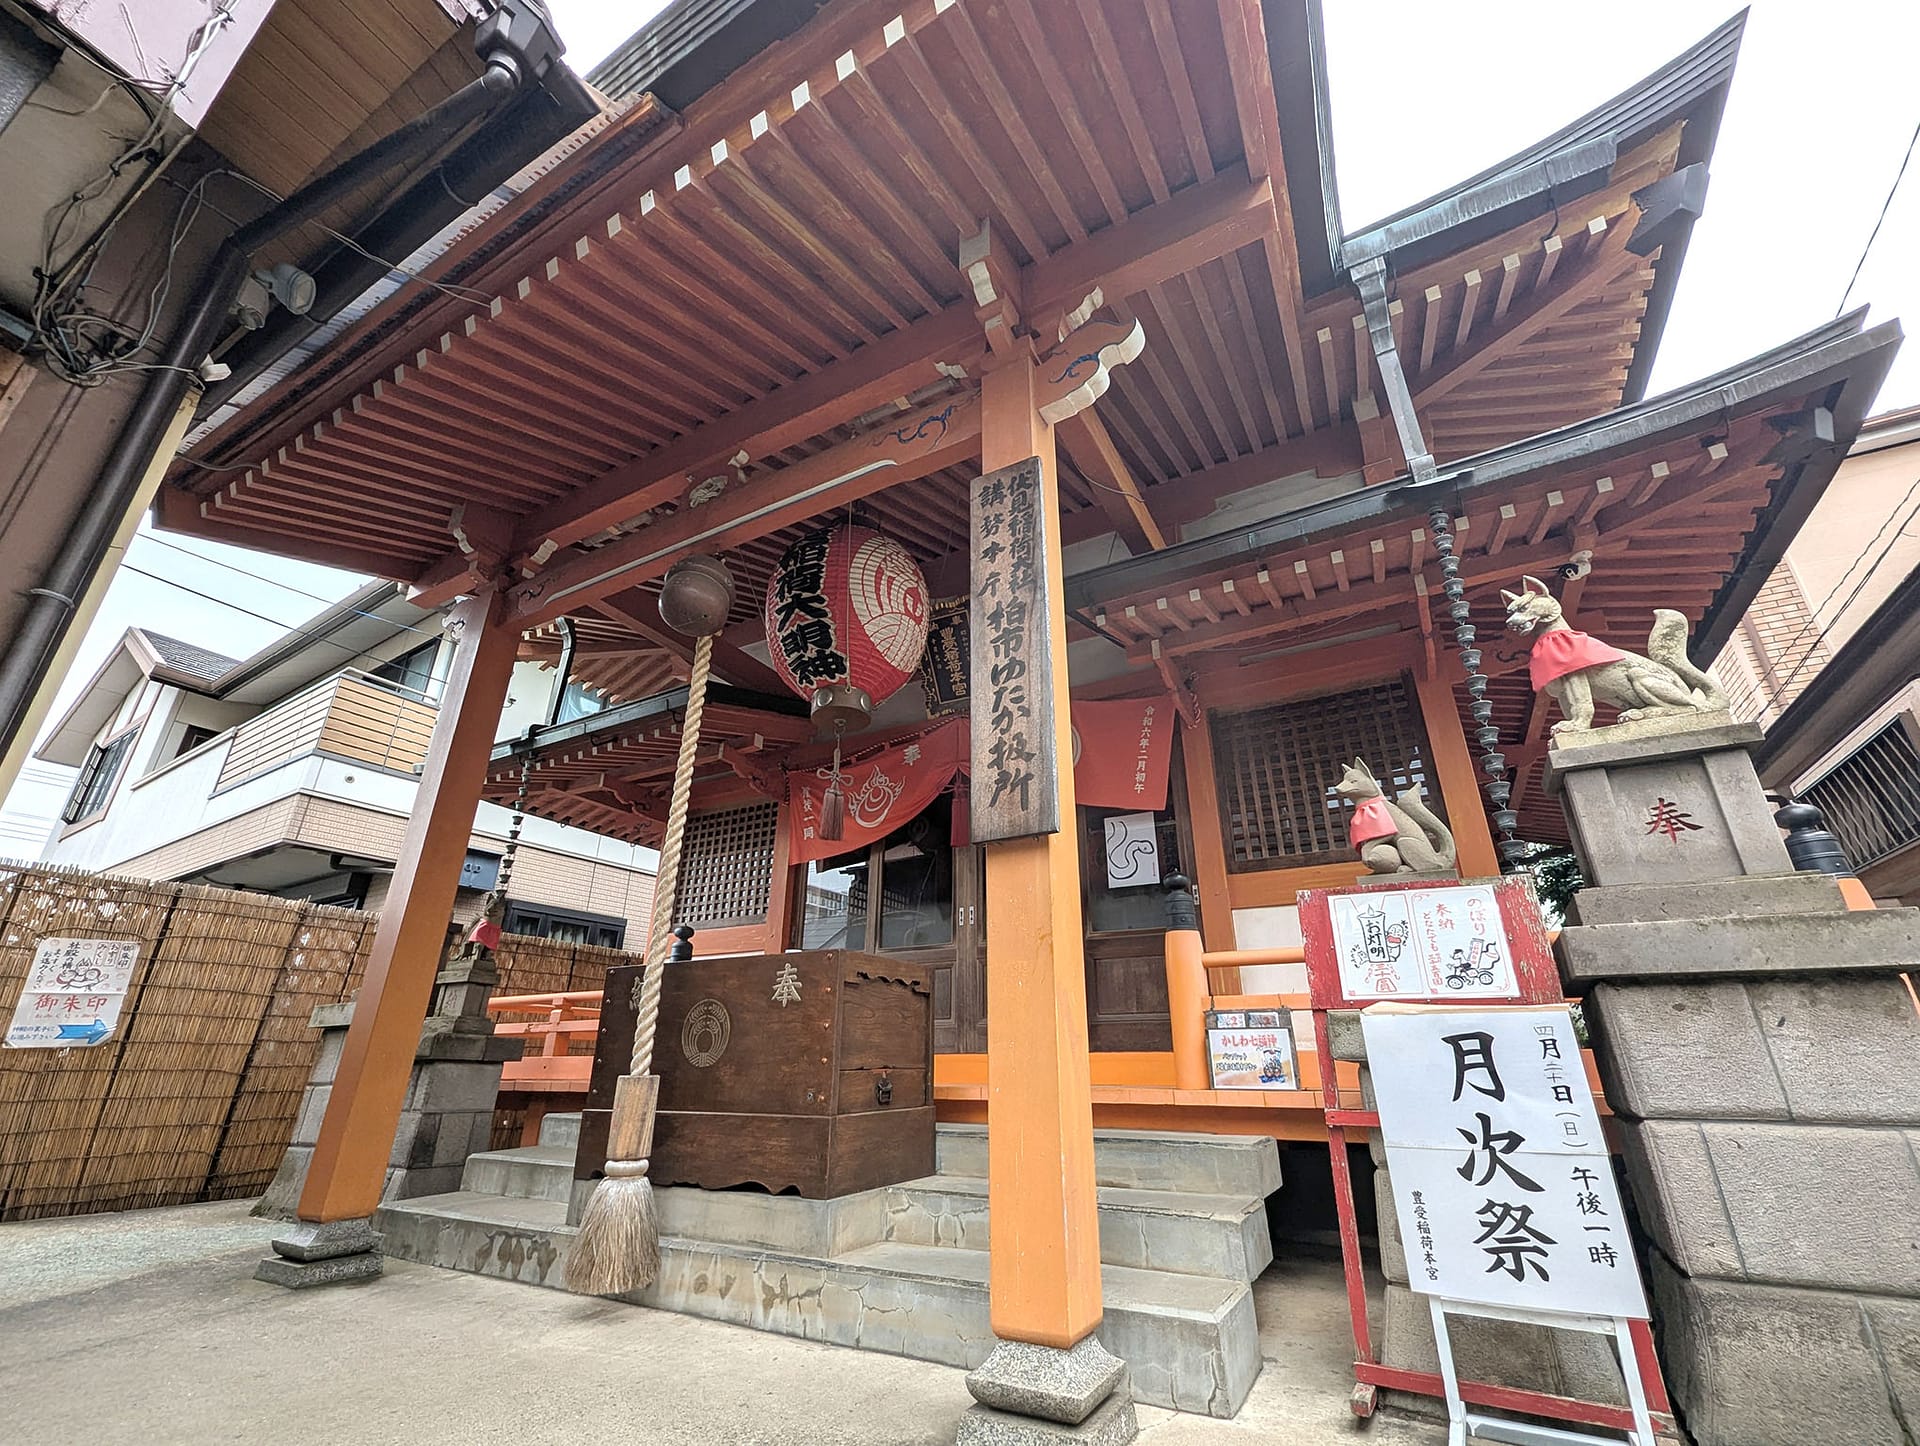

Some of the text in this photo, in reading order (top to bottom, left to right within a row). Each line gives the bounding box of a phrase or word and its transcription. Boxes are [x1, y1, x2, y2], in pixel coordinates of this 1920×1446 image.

[903, 744, 921, 766] 奉
[1134, 705, 1155, 794] 令和六年二月初午
[1645, 797, 1704, 844] 奉
[1366, 920, 1386, 959] お灯明
[1435, 903, 1455, 930] 奉納
[1467, 898, 1486, 936] のぼり
[34, 994, 107, 1012] 御朱印
[771, 962, 802, 1008] 奉
[1441, 1030, 1559, 1283] 月次祭
[1412, 1190, 1439, 1280] 豊受稲荷本宮
[1570, 1165, 1619, 1268] 午後一時
